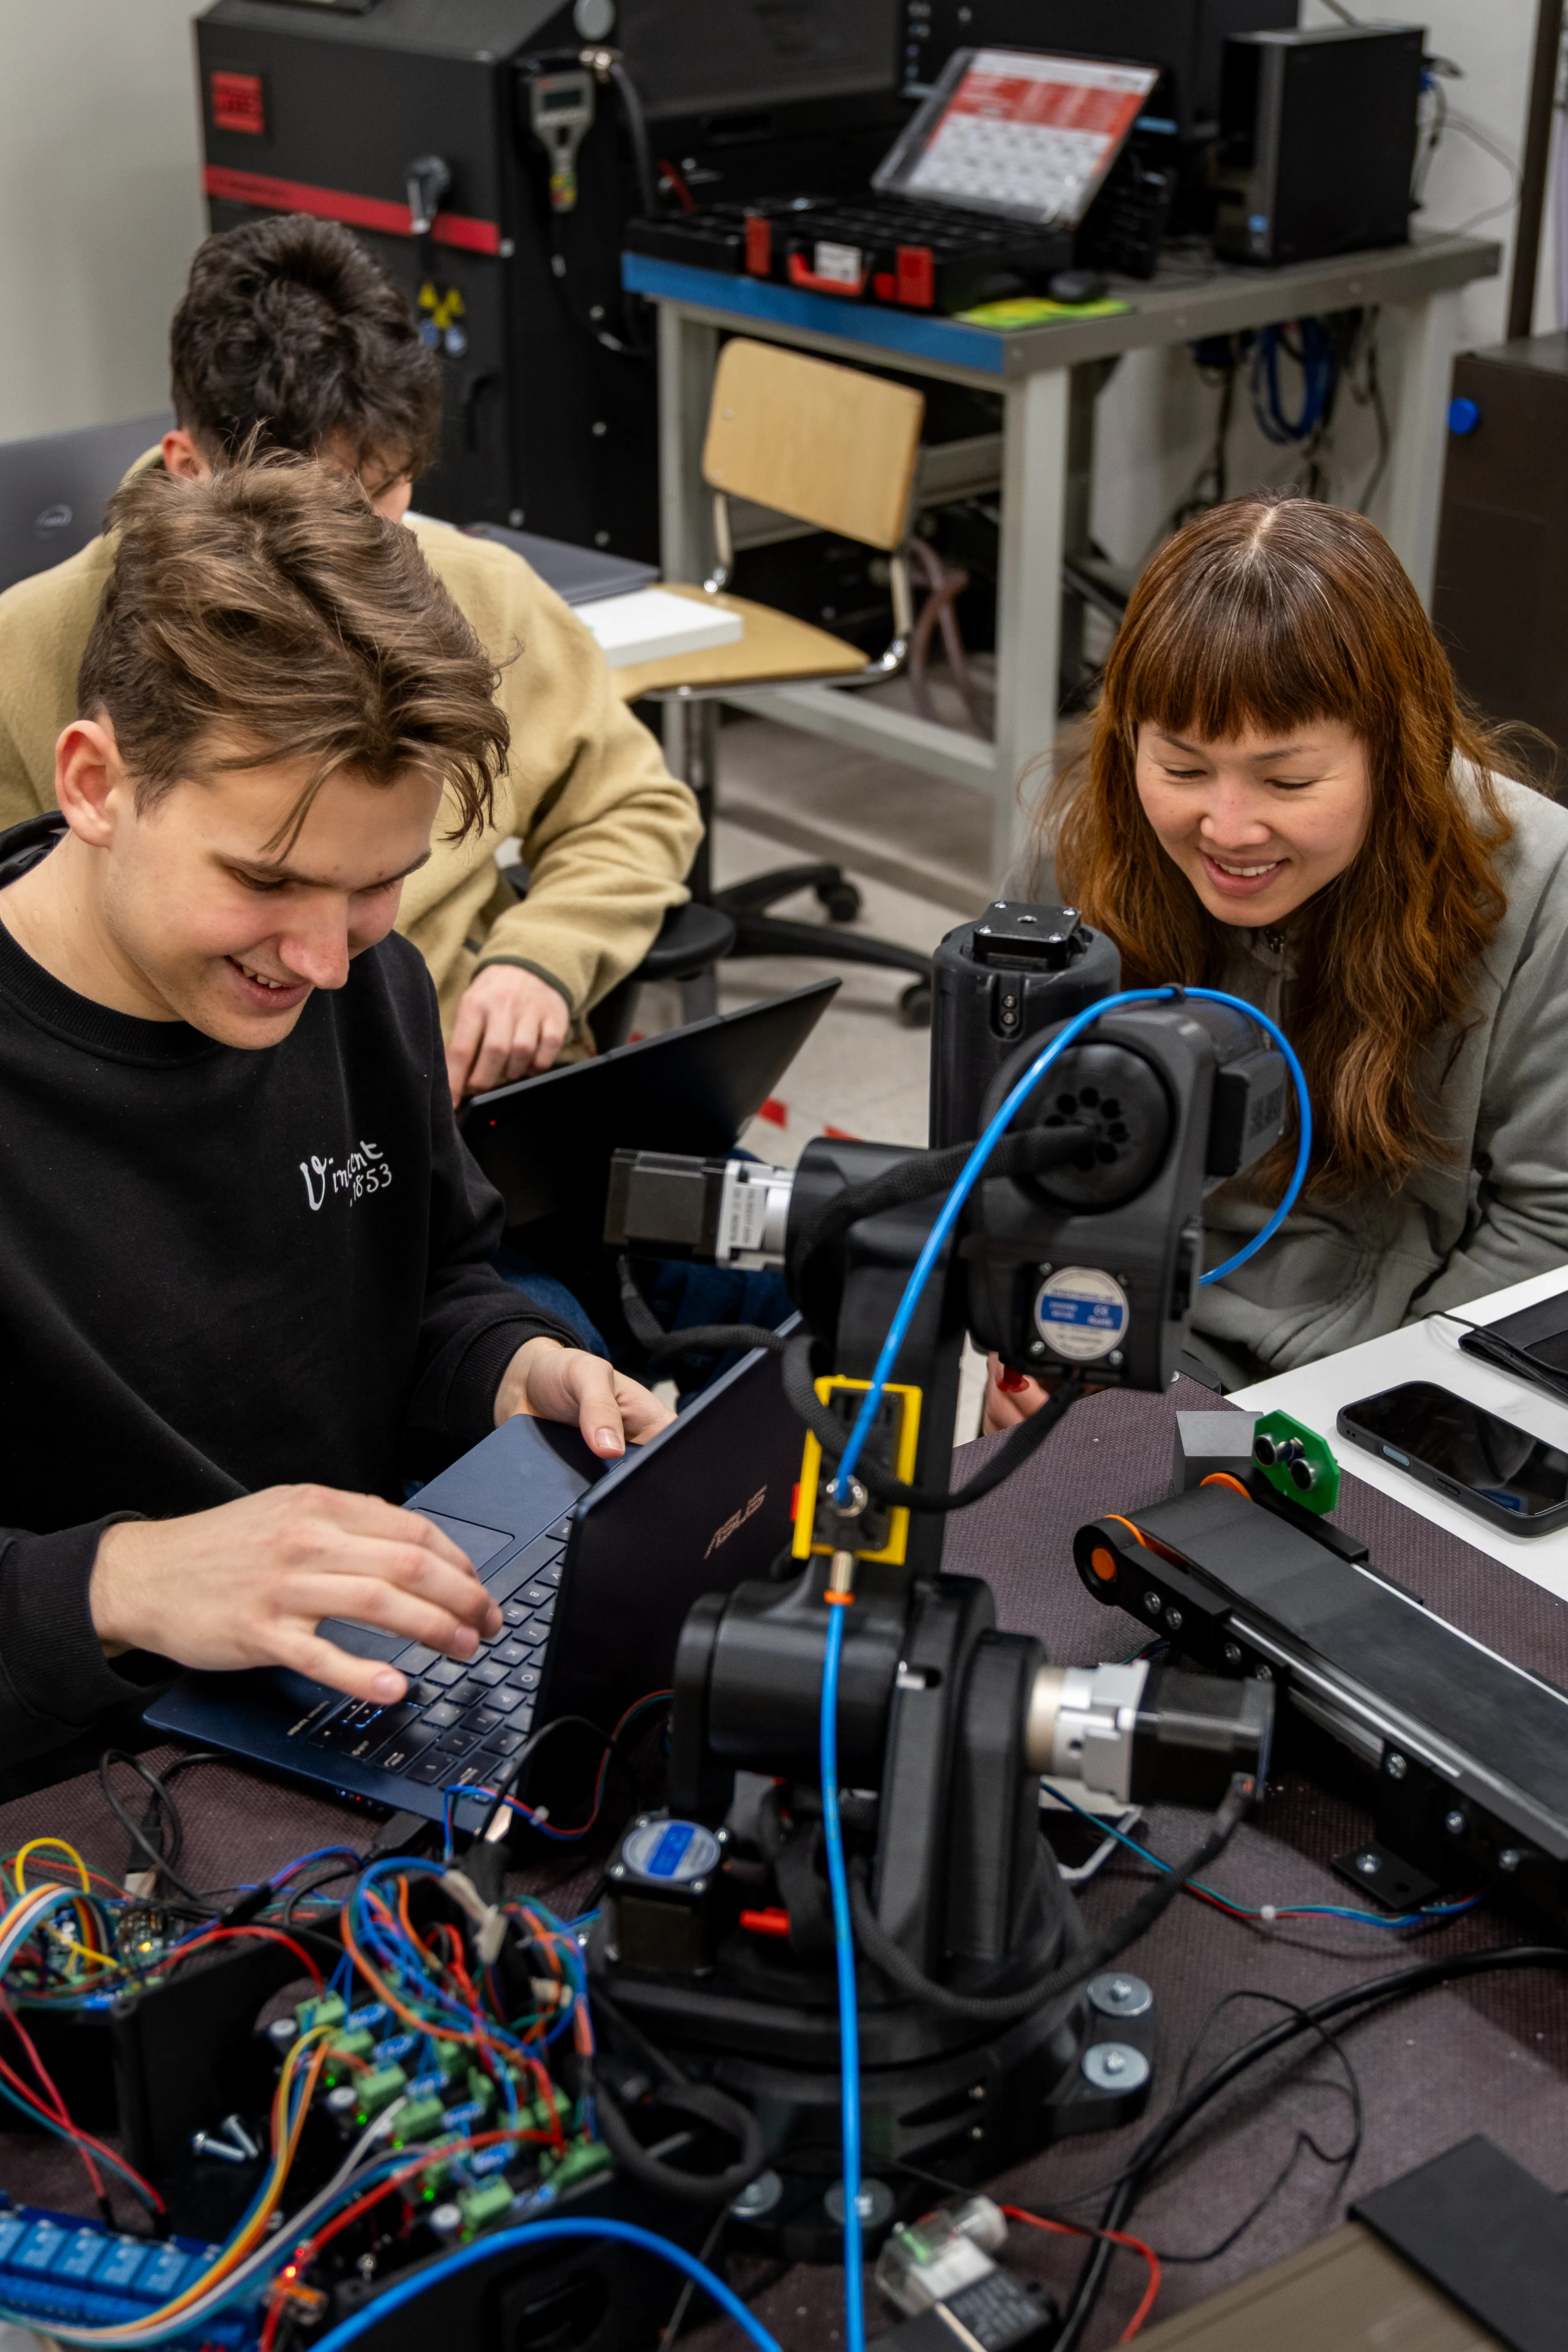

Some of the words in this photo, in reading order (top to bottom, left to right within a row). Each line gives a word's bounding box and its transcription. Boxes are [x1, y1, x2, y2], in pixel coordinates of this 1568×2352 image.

[300, 1140, 384, 1211] Vincent
[507, 1610, 519, 1618] N
[521, 1674, 534, 1683] O
